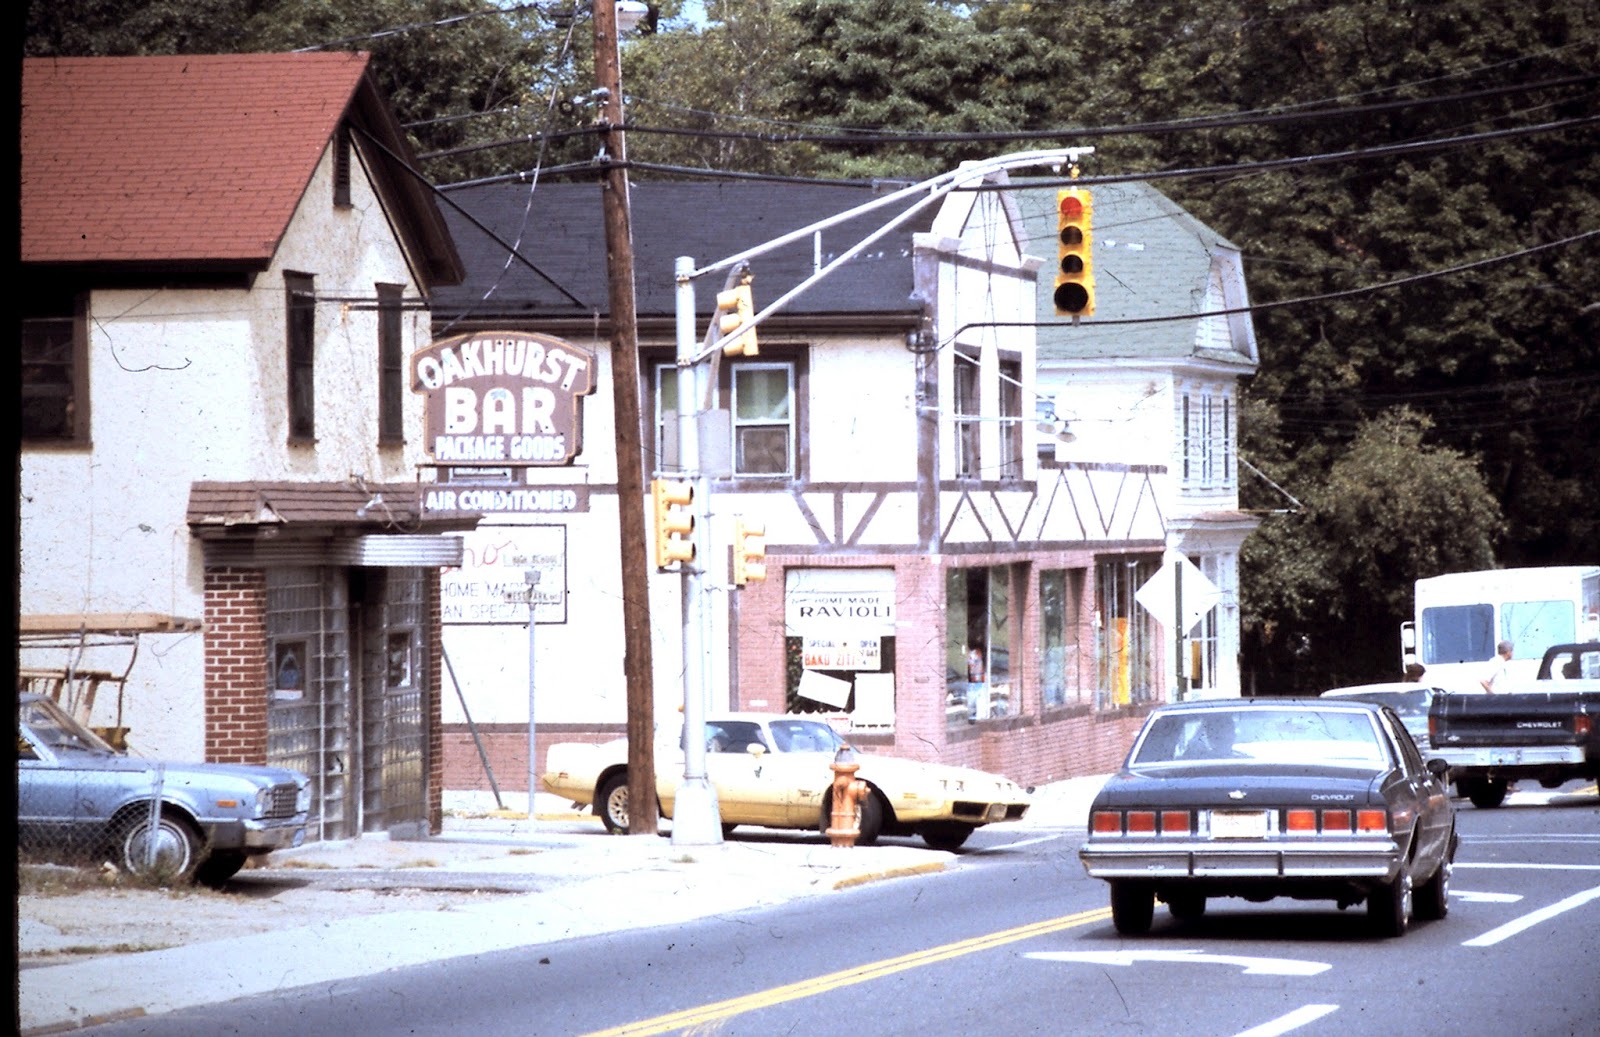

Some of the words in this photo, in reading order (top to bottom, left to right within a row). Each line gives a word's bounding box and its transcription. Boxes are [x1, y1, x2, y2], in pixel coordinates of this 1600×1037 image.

[417, 339, 587, 392] OAKHURST
[445, 387, 556, 434] BAR
[435, 436, 505, 460] PACKAGE
[510, 436, 565, 460] GOODS
[425, 490, 457, 511] AIR
[458, 490, 577, 511] CONDITIONED
[800, 606, 891, 617] RAVIOLI
[1516, 721, 1562, 729] CHEVROLET
